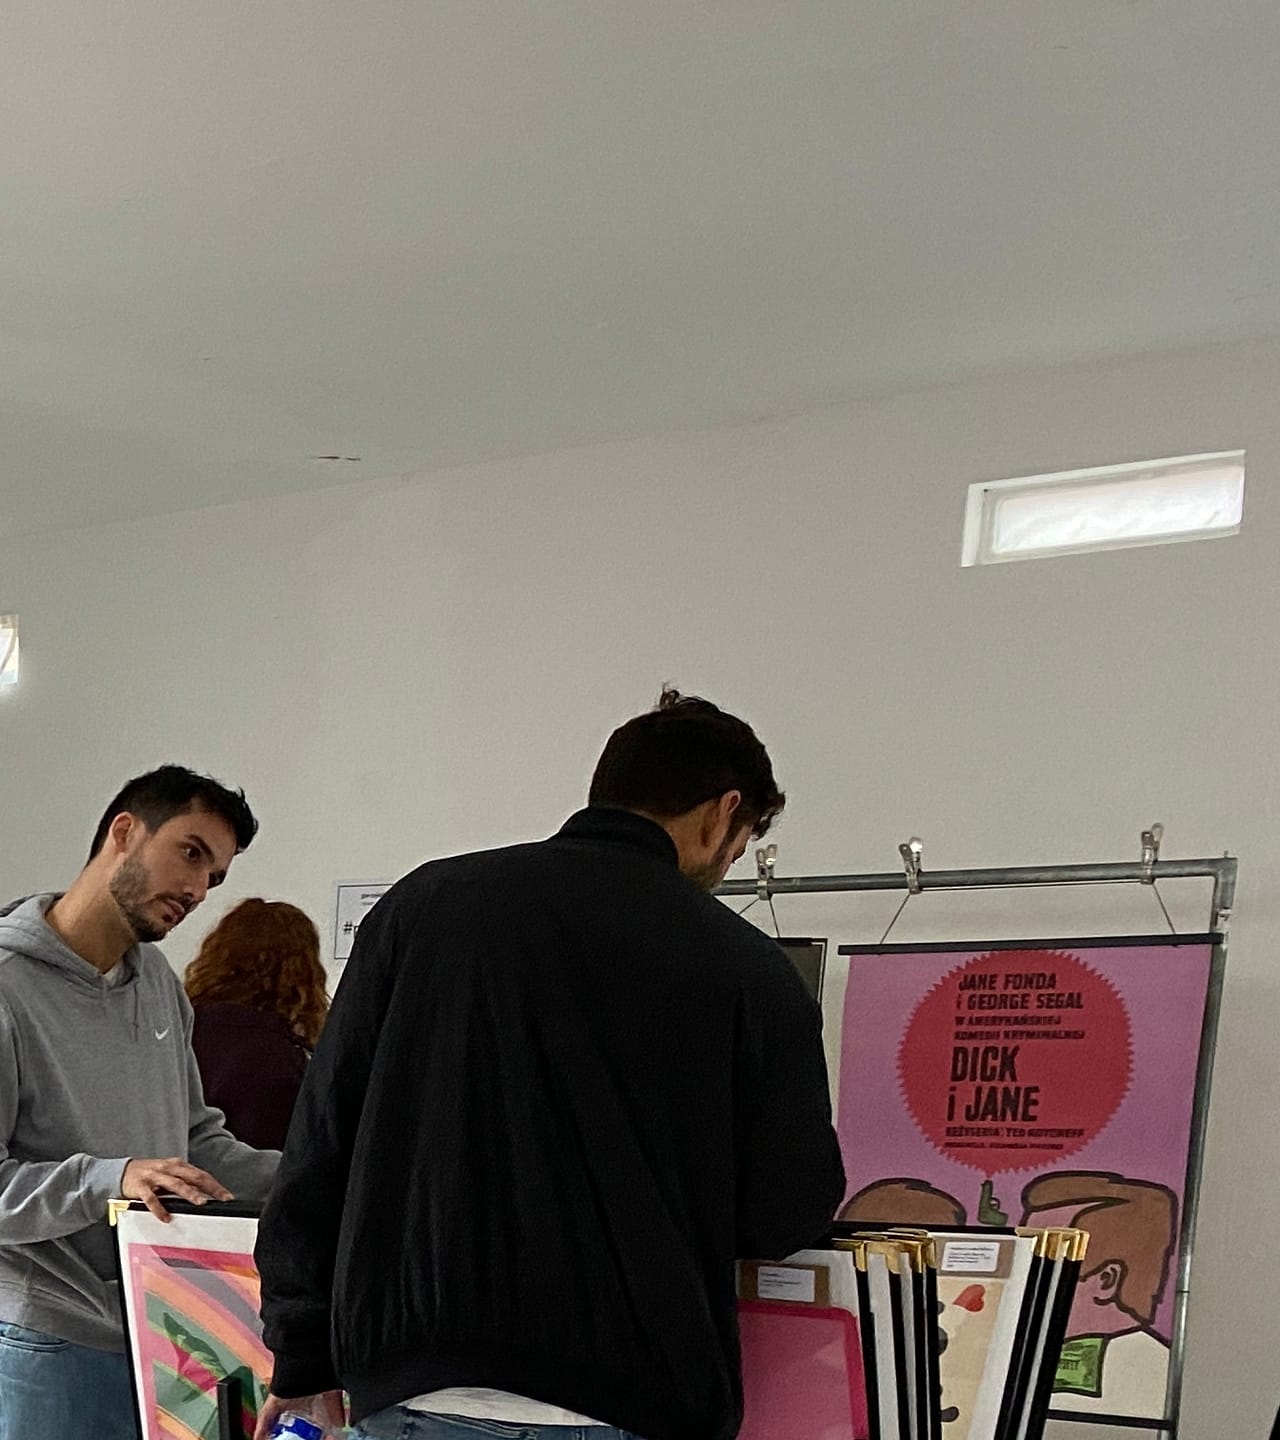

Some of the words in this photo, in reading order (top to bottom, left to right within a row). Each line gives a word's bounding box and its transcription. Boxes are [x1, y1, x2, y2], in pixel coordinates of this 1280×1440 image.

[958, 973, 997, 991] JANE
[1003, 973, 1056, 990] FONDA
[967, 993, 1029, 1010] GEORGE
[1036, 992, 1084, 1009] SEGAL
[951, 1045, 1020, 1082] DICK
[965, 1086, 1040, 1122] JANE
